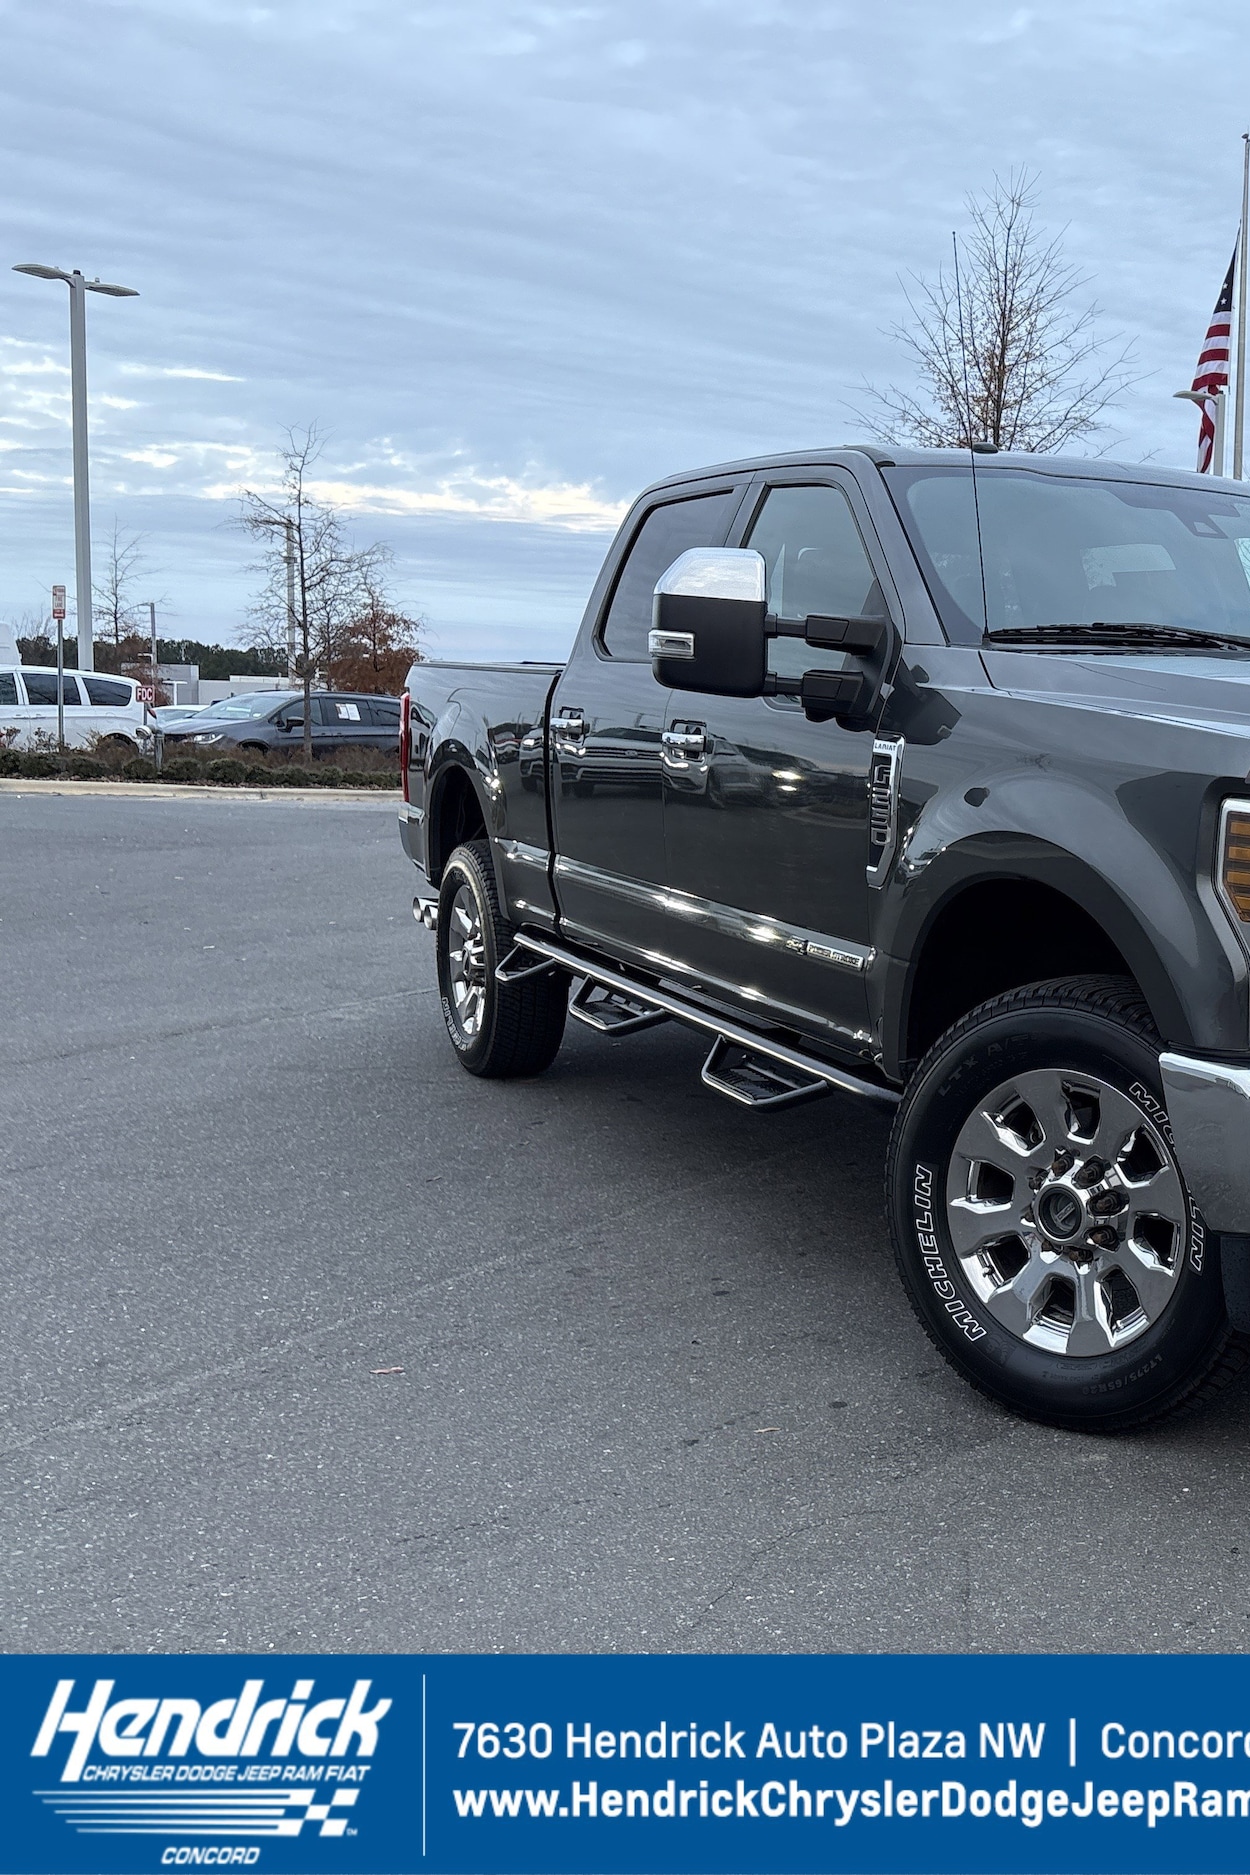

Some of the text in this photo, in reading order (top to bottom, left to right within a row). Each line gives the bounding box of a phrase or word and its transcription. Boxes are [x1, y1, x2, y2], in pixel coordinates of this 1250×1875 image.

[136, 687, 153, 701] FDC
[874, 741, 897, 752] LARIAT
[912, 1164, 988, 1343] MICHELIN
